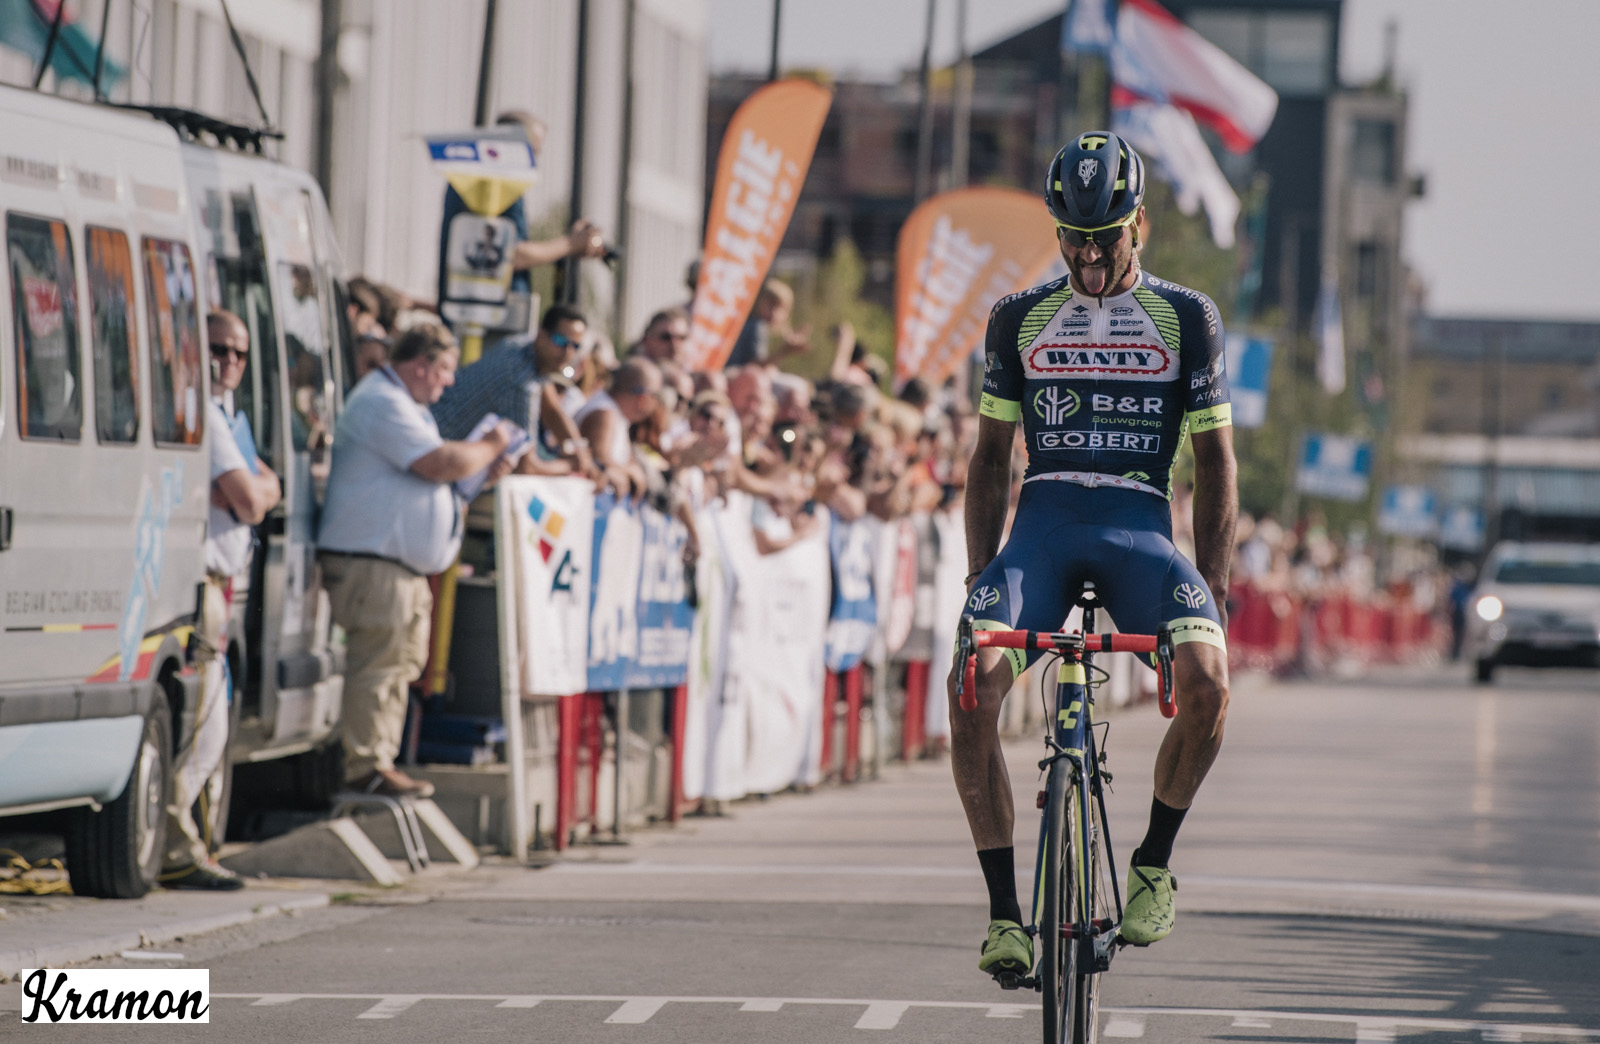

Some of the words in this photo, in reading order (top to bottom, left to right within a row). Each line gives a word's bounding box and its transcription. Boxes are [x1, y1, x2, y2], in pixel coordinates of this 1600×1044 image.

[1162, 282, 1217, 336] startpeople
[1046, 351, 1151, 366] WANTY
[1092, 394, 1163, 414] B&R
[1092, 415, 1162, 428] Bouwgroep
[1042, 432, 1153, 450] GOBERT
[1172, 625, 1220, 637] CUBE
